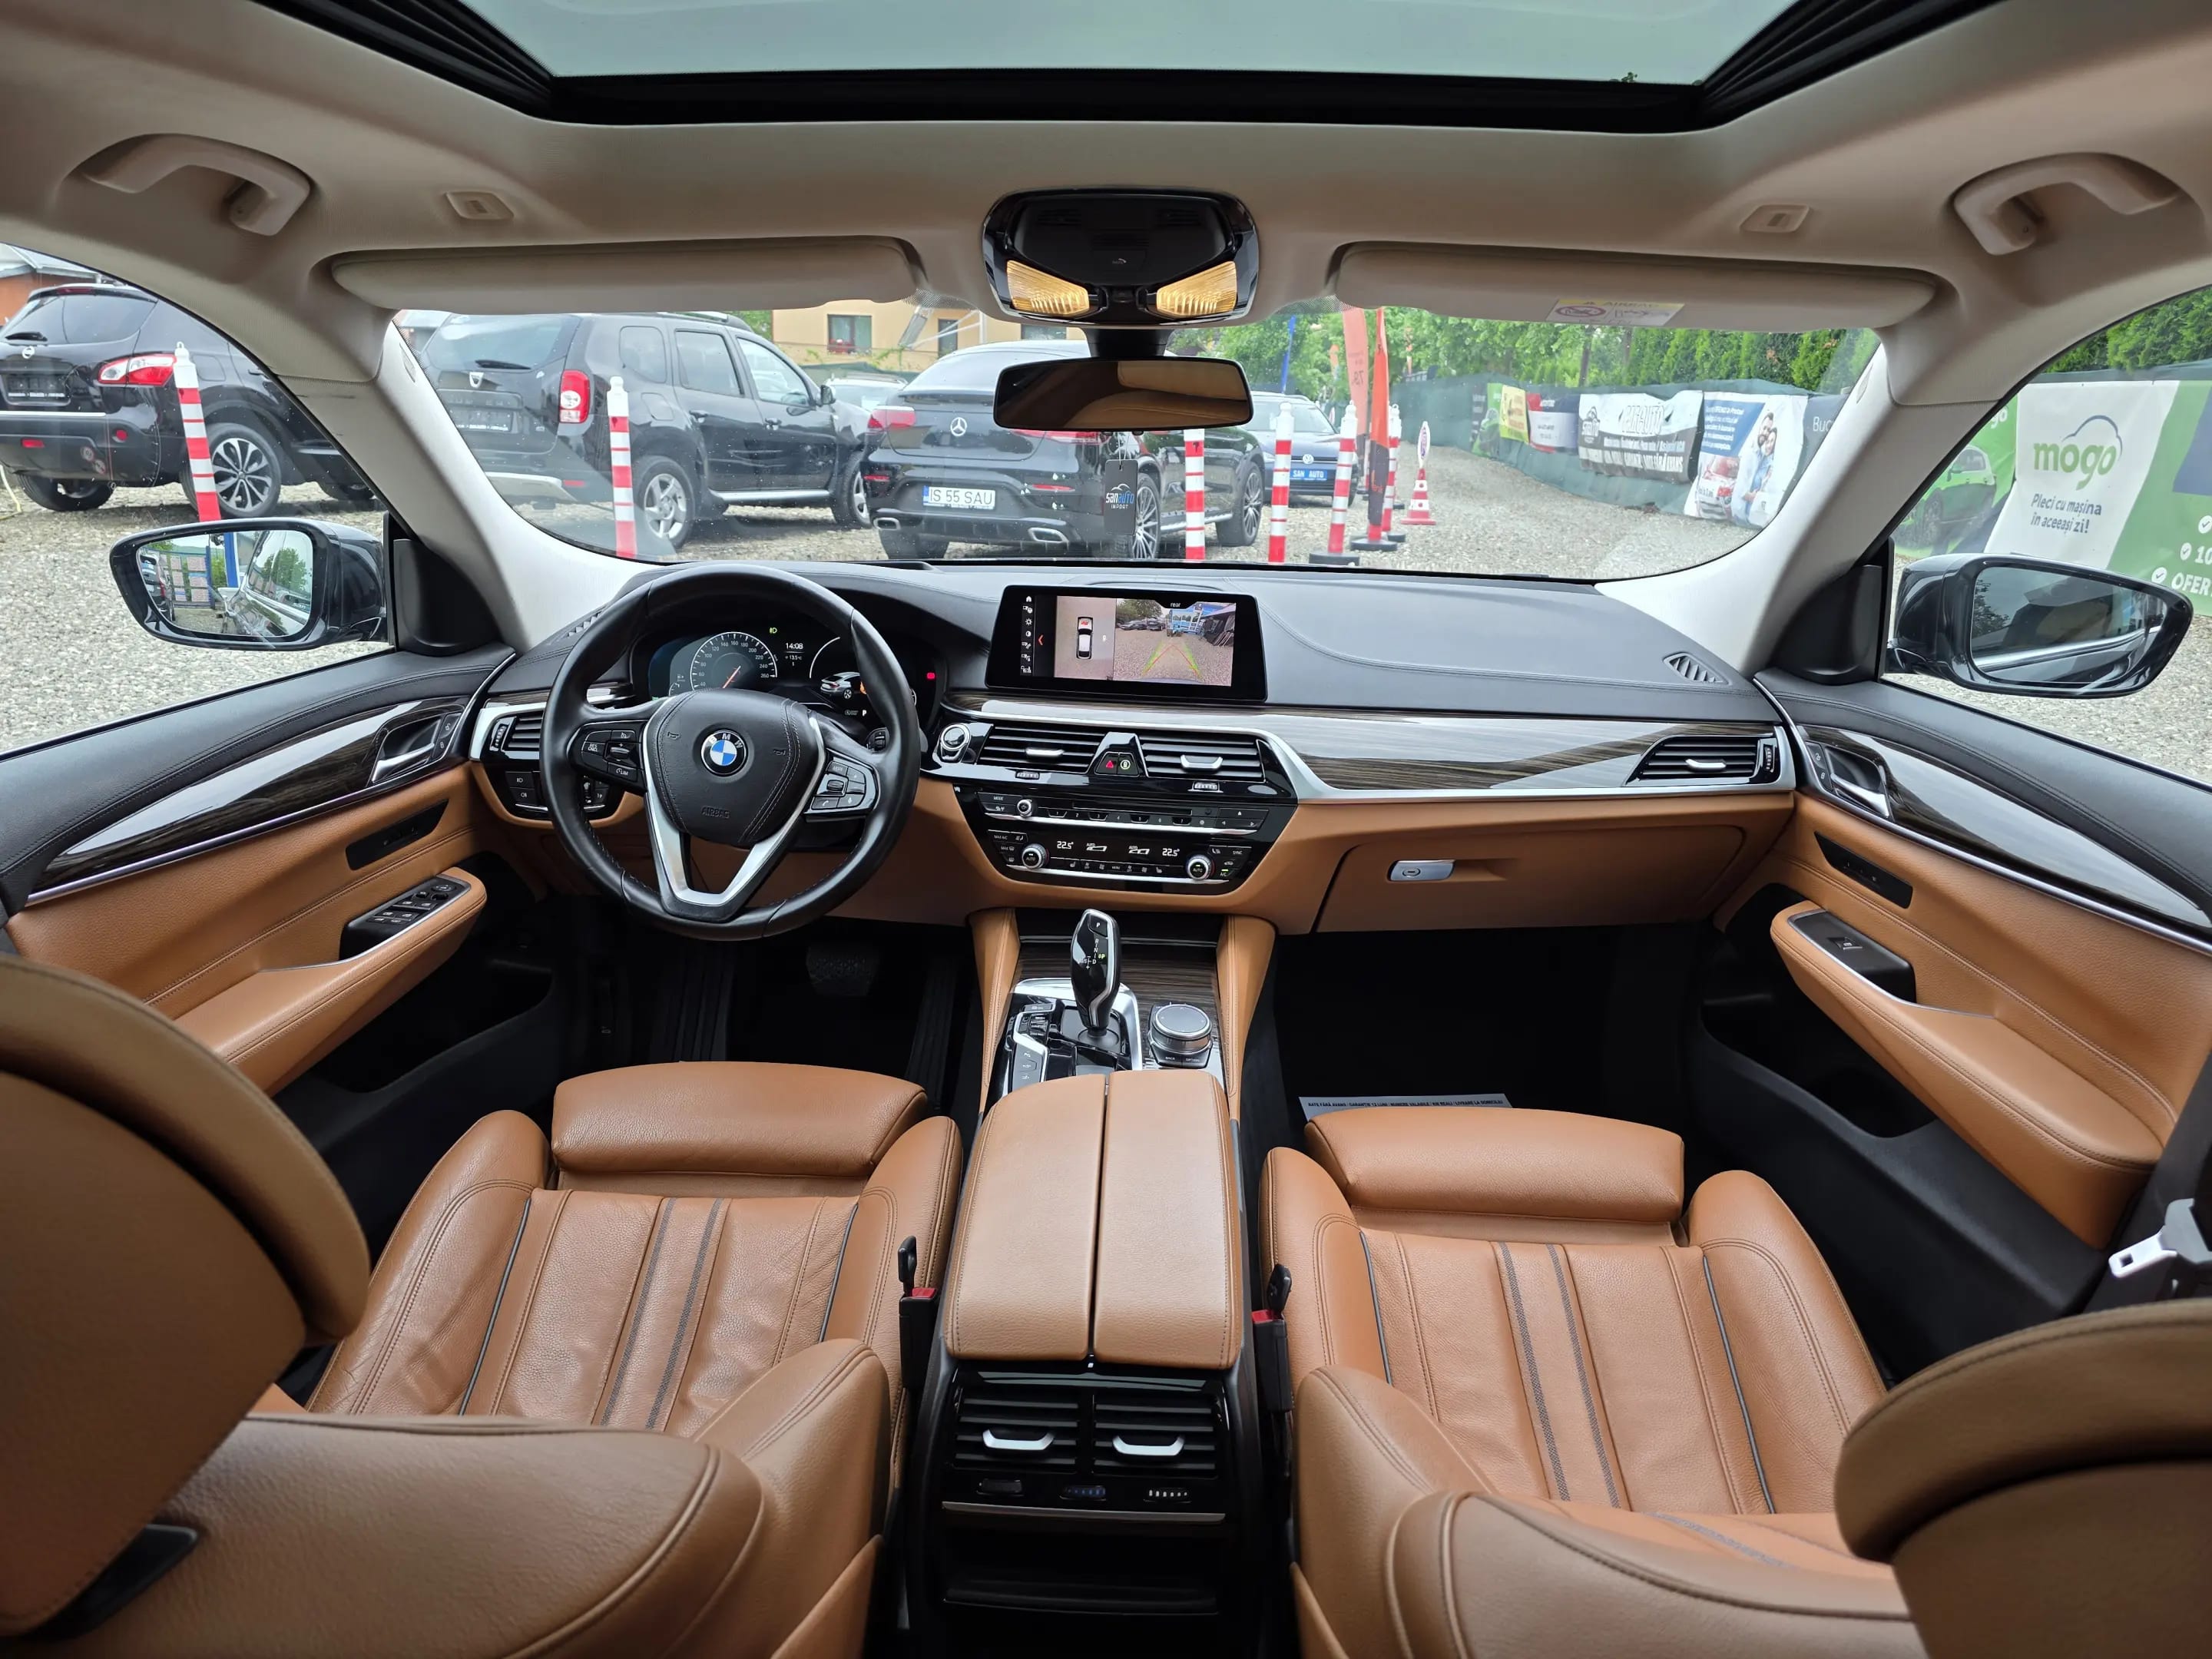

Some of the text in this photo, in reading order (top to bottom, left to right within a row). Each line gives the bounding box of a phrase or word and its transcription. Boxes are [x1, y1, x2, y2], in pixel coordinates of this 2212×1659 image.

[2034, 443, 2117, 491] mogo
[930, 488, 992, 505] IS 55 SAU
[2031, 493, 2056, 510] Pleci
[2055, 500, 2066, 511] cu
[2073, 518, 2090, 534] zi!
[2171, 572, 2212, 598] OFER
[707, 733, 743, 749] BMW
[701, 806, 730, 820] AIRBAG
